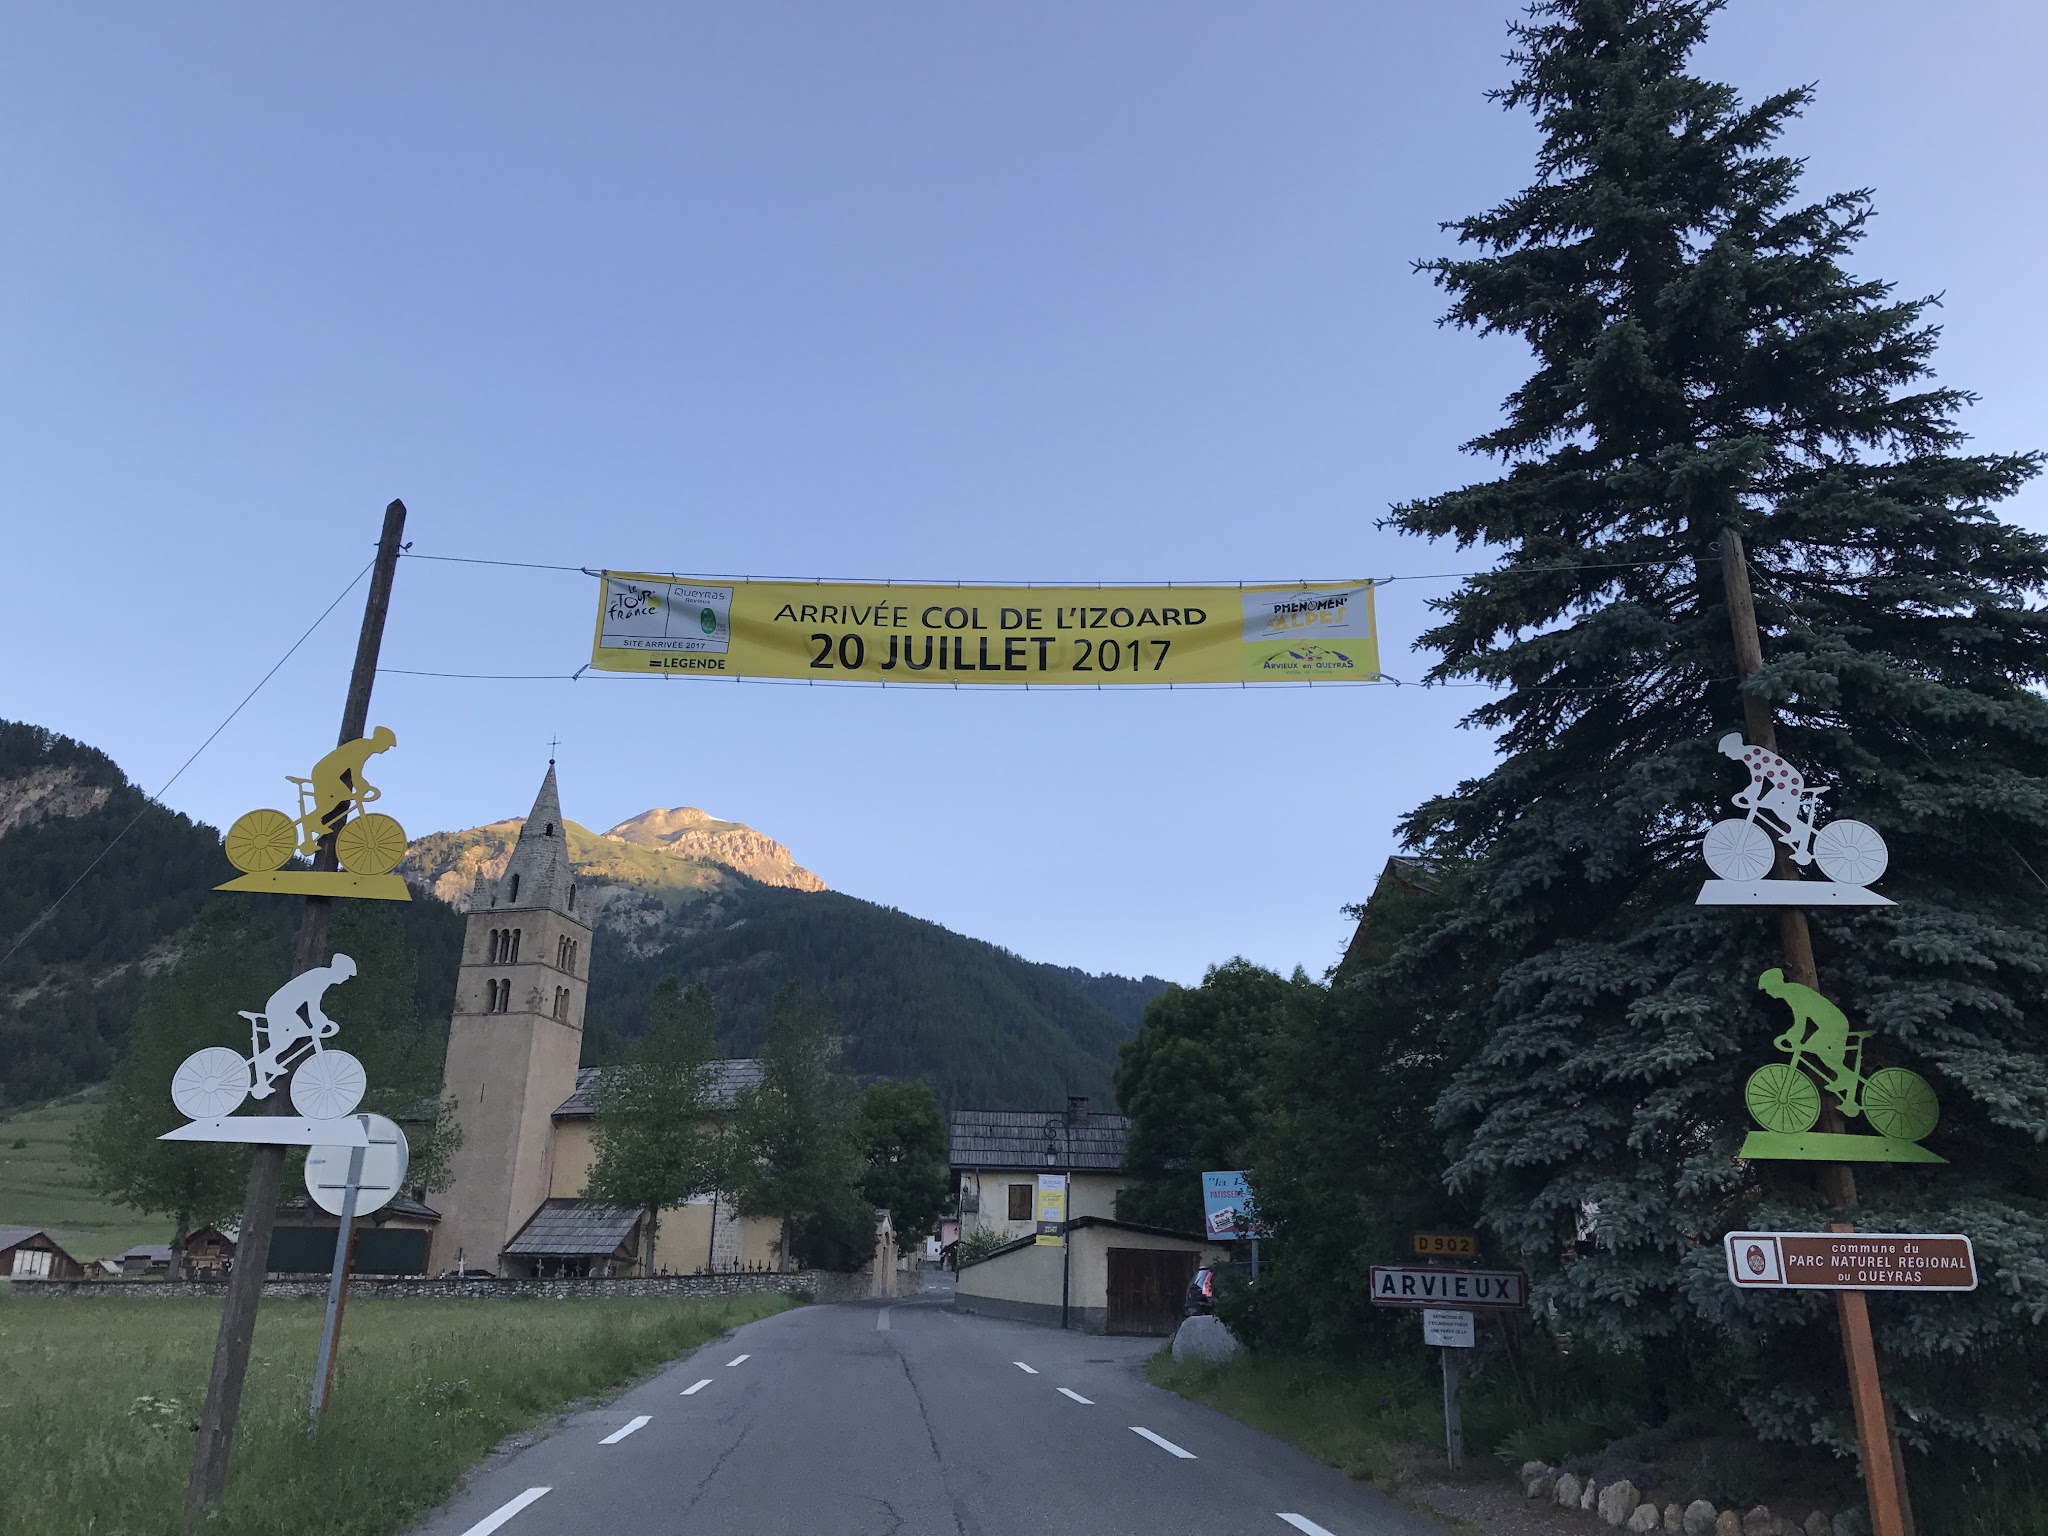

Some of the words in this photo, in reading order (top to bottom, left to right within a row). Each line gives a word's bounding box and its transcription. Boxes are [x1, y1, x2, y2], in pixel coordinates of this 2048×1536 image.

[773, 600, 909, 627] ARRIVÉE
[921, 606, 988, 630] COL
[1000, 607, 1043, 630] DE
[1056, 606, 1208, 630] L'IZOARD
[623, 640, 643, 648] SITE
[686, 641, 706, 650] 2017
[809, 633, 865, 669] 20
[881, 635, 1056, 671] JUILLET
[1072, 639, 1172, 672] 2017
[663, 658, 726, 670] LEGENDE
[1832, 1243, 1896, 1255] commune
[1904, 1242, 1920, 1254] du
[1789, 1255, 1824, 1267] PARC
[1830, 1255, 1892, 1268] NATUREL
[1898, 1256, 1967, 1269] REGIONAL
[1838, 1273, 1851, 1282] DU
[1857, 1270, 1922, 1283] QUEYRAS
[1382, 1274, 1511, 1299] ARVIEUX
